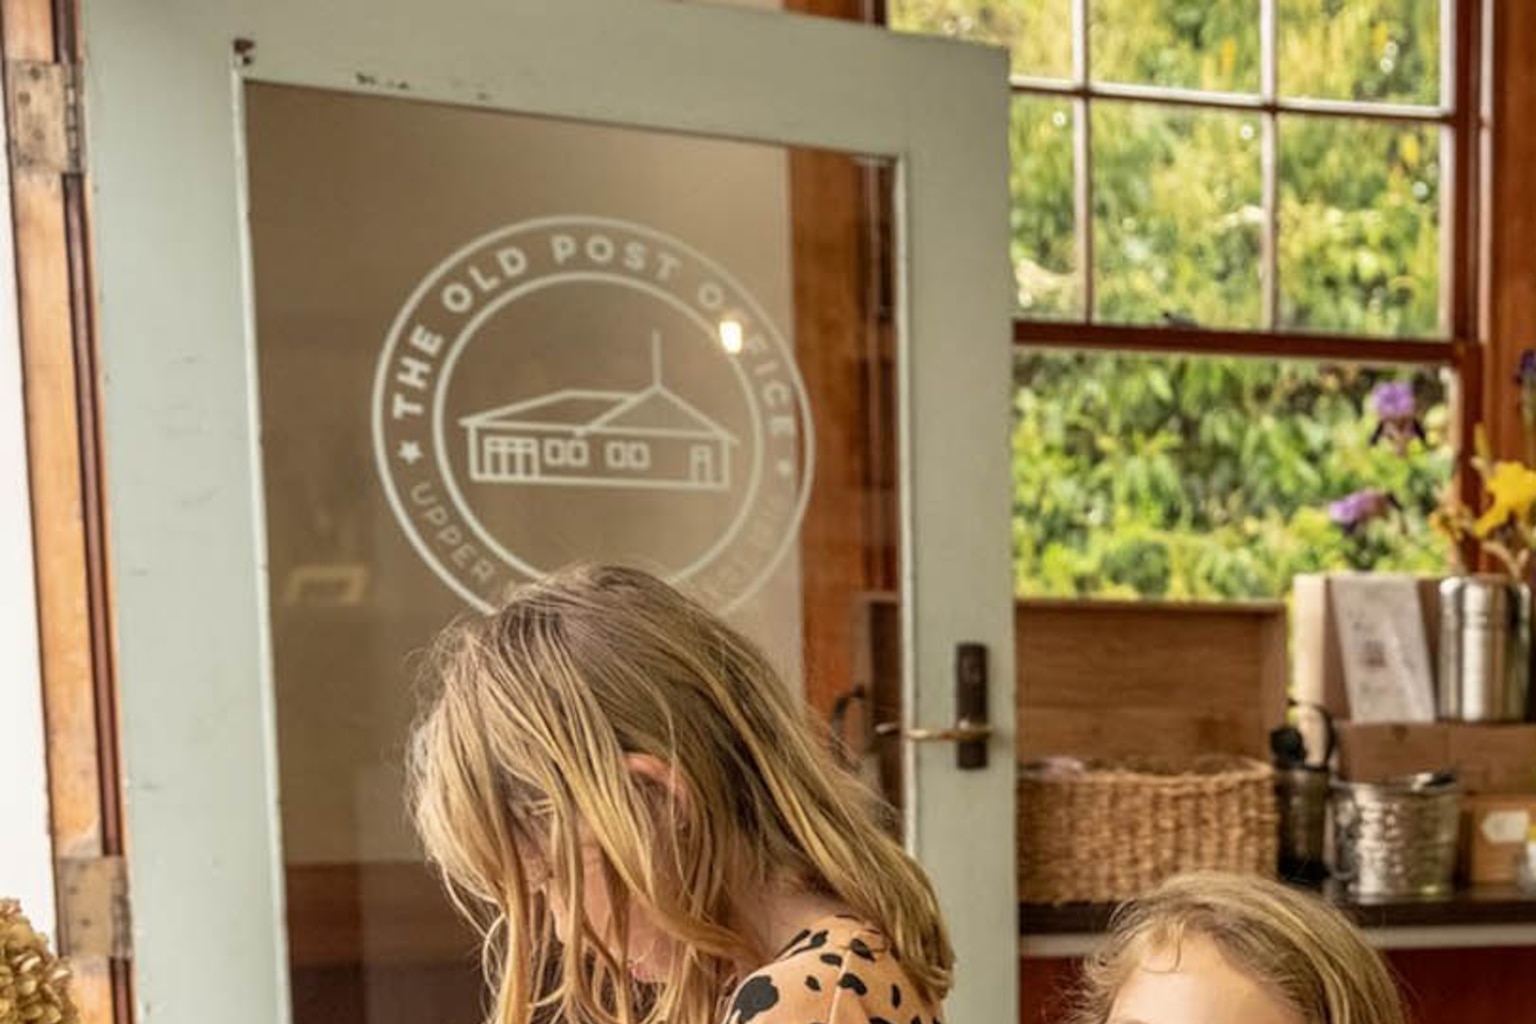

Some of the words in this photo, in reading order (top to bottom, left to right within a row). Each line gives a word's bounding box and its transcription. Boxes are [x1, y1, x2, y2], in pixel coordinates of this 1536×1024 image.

[392, 324, 444, 421] THE
[442, 246, 528, 314] OLD
[551, 234, 684, 280] POST
[410, 482, 497, 585] UPPER
